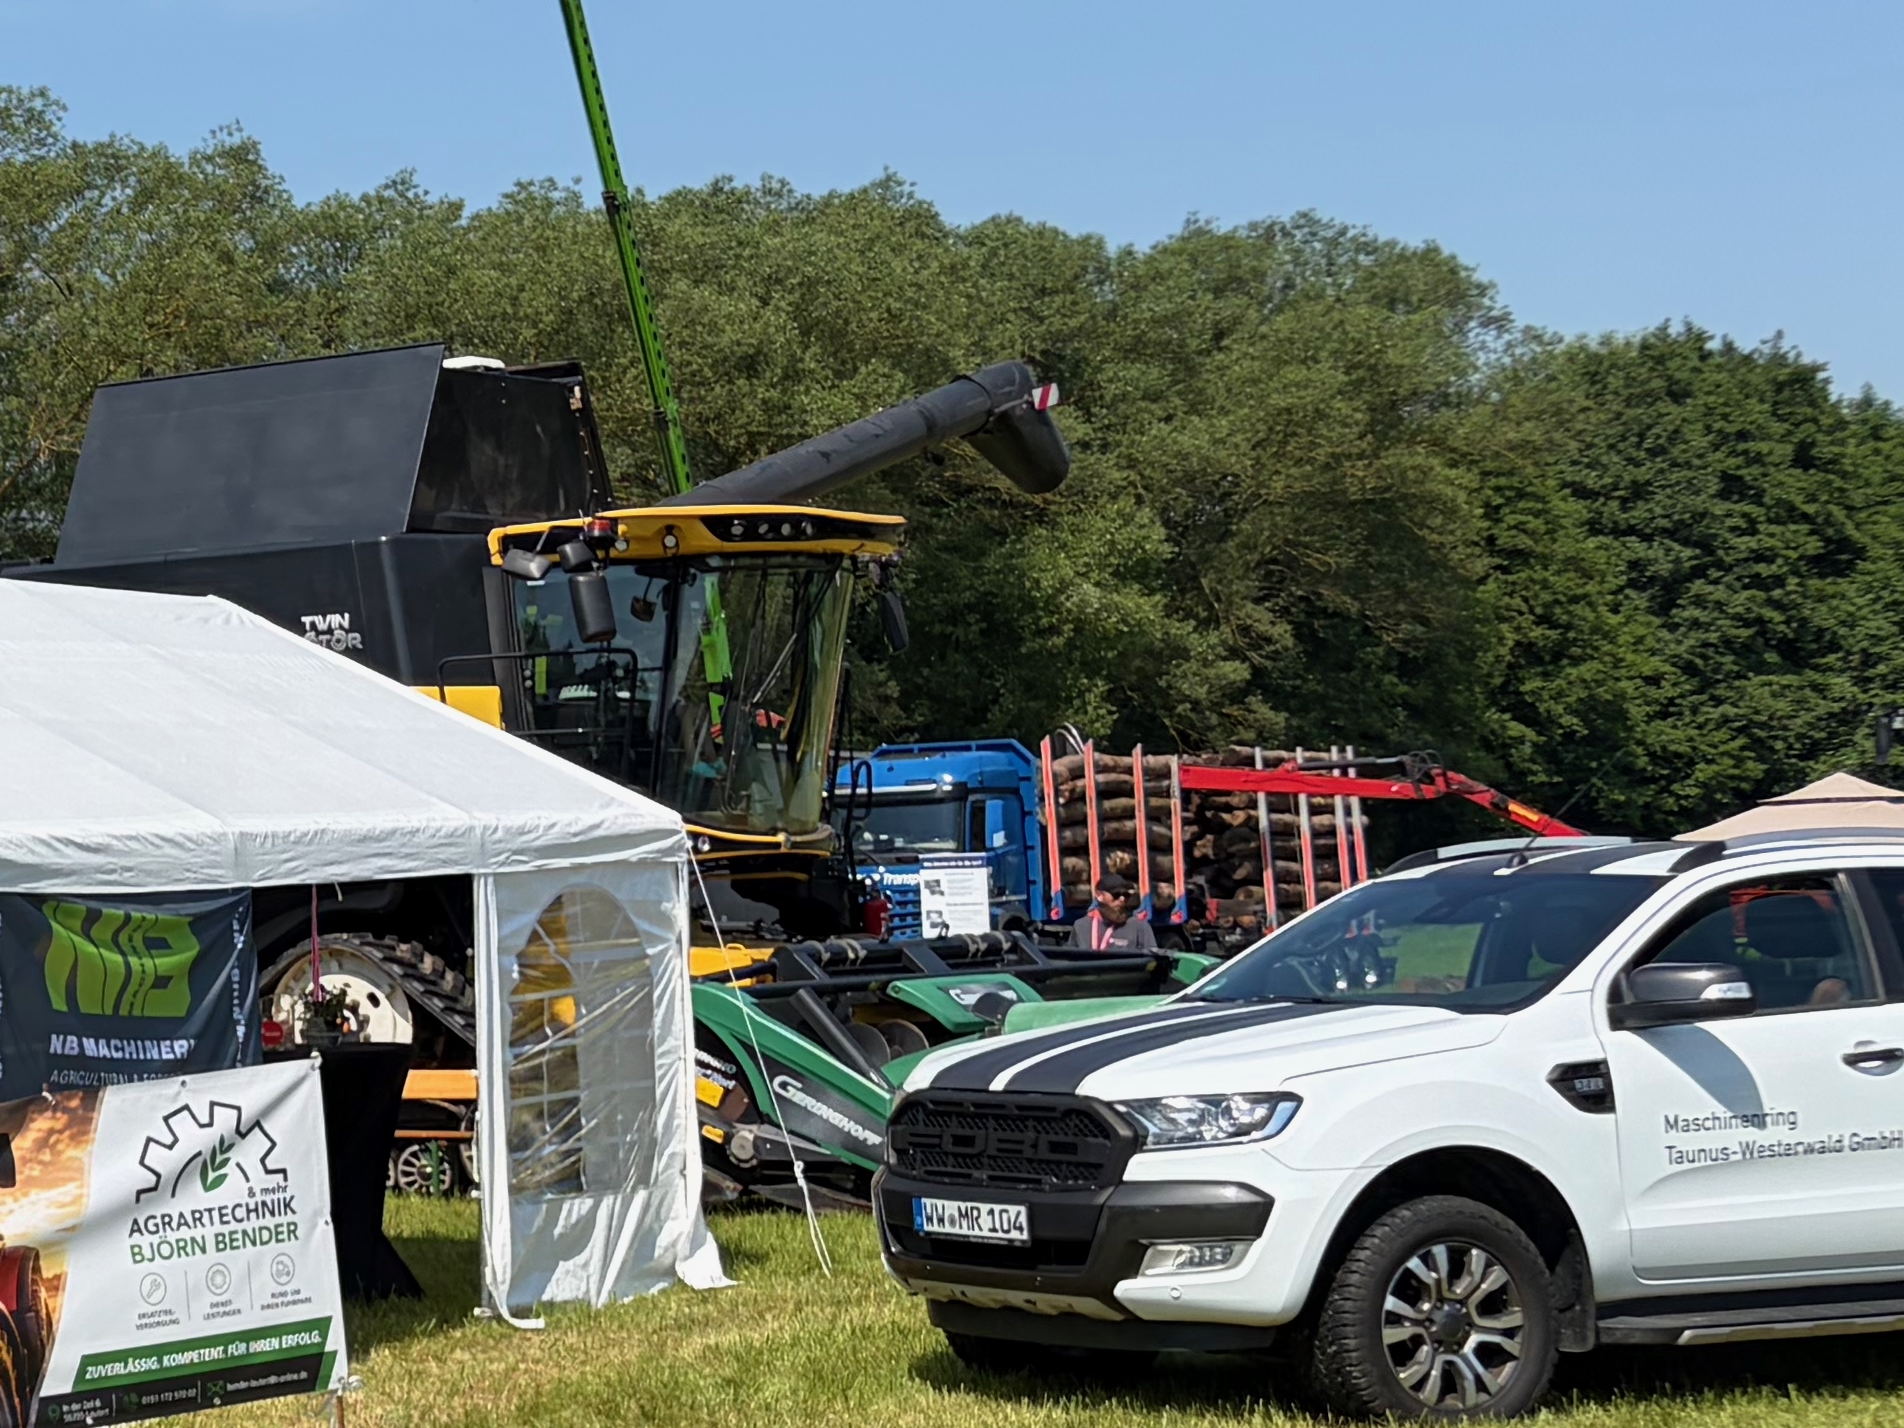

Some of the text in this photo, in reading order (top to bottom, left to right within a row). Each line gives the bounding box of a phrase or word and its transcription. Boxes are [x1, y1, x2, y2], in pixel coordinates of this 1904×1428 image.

[301, 612, 350, 632] TWIN
[883, 872, 920, 885] Transp
[49, 1033, 80, 1056] NB
[1664, 1108, 1799, 1134] Maschinenring
[1664, 1129, 1904, 1165] Taunus-Westerwald GmbH
[247, 1182, 289, 1199] & mehr
[128, 1195, 297, 1239] AGRARTECHNIK
[923, 1201, 1026, 1236] WW MR 104
[129, 1221, 300, 1265] BJÖRN BENDER
[84, 1329, 323, 1380] ZUVERLÄSSIG. KOMPETENT. FÜR IHREN ERFOLG.
